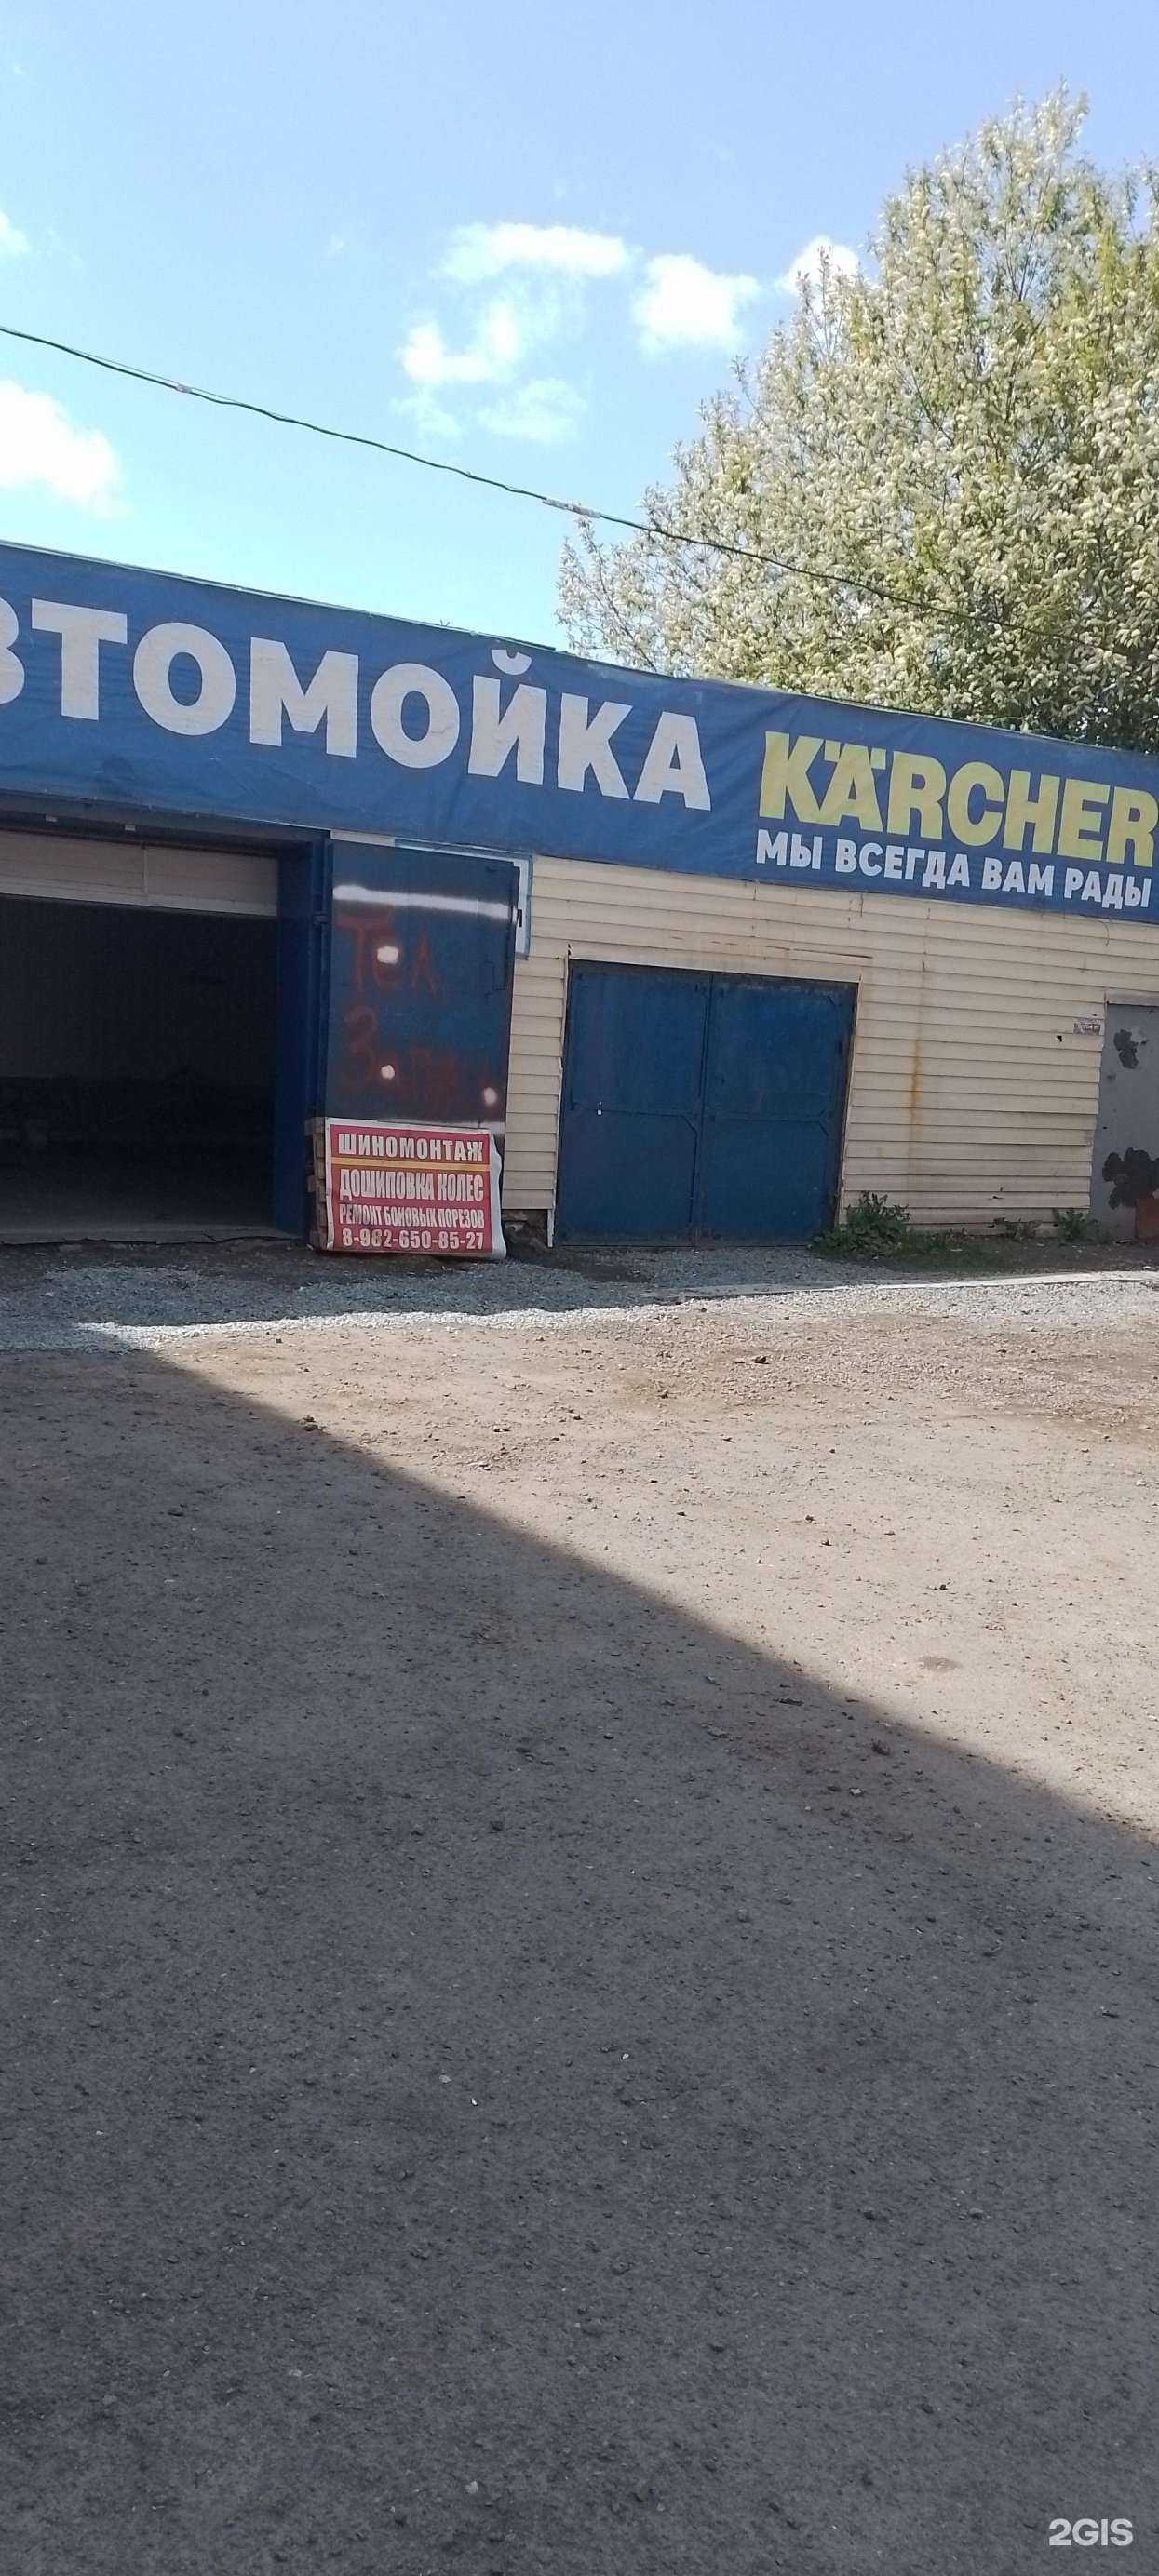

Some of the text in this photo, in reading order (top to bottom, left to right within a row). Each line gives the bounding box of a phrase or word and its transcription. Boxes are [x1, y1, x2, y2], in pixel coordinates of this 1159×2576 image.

[756, 829, 1152, 910] МЫ ВСЕГДА ВАМ РАДЫ
[338, 1133, 483, 1161] ШИНОМОНТАЖ
[339, 1168, 484, 1202] ДОШИПОВКА КОЛЕС
[339, 1203, 485, 1228] РЕМОНТ БОКОВЫХ ПОРЕЗОВ
